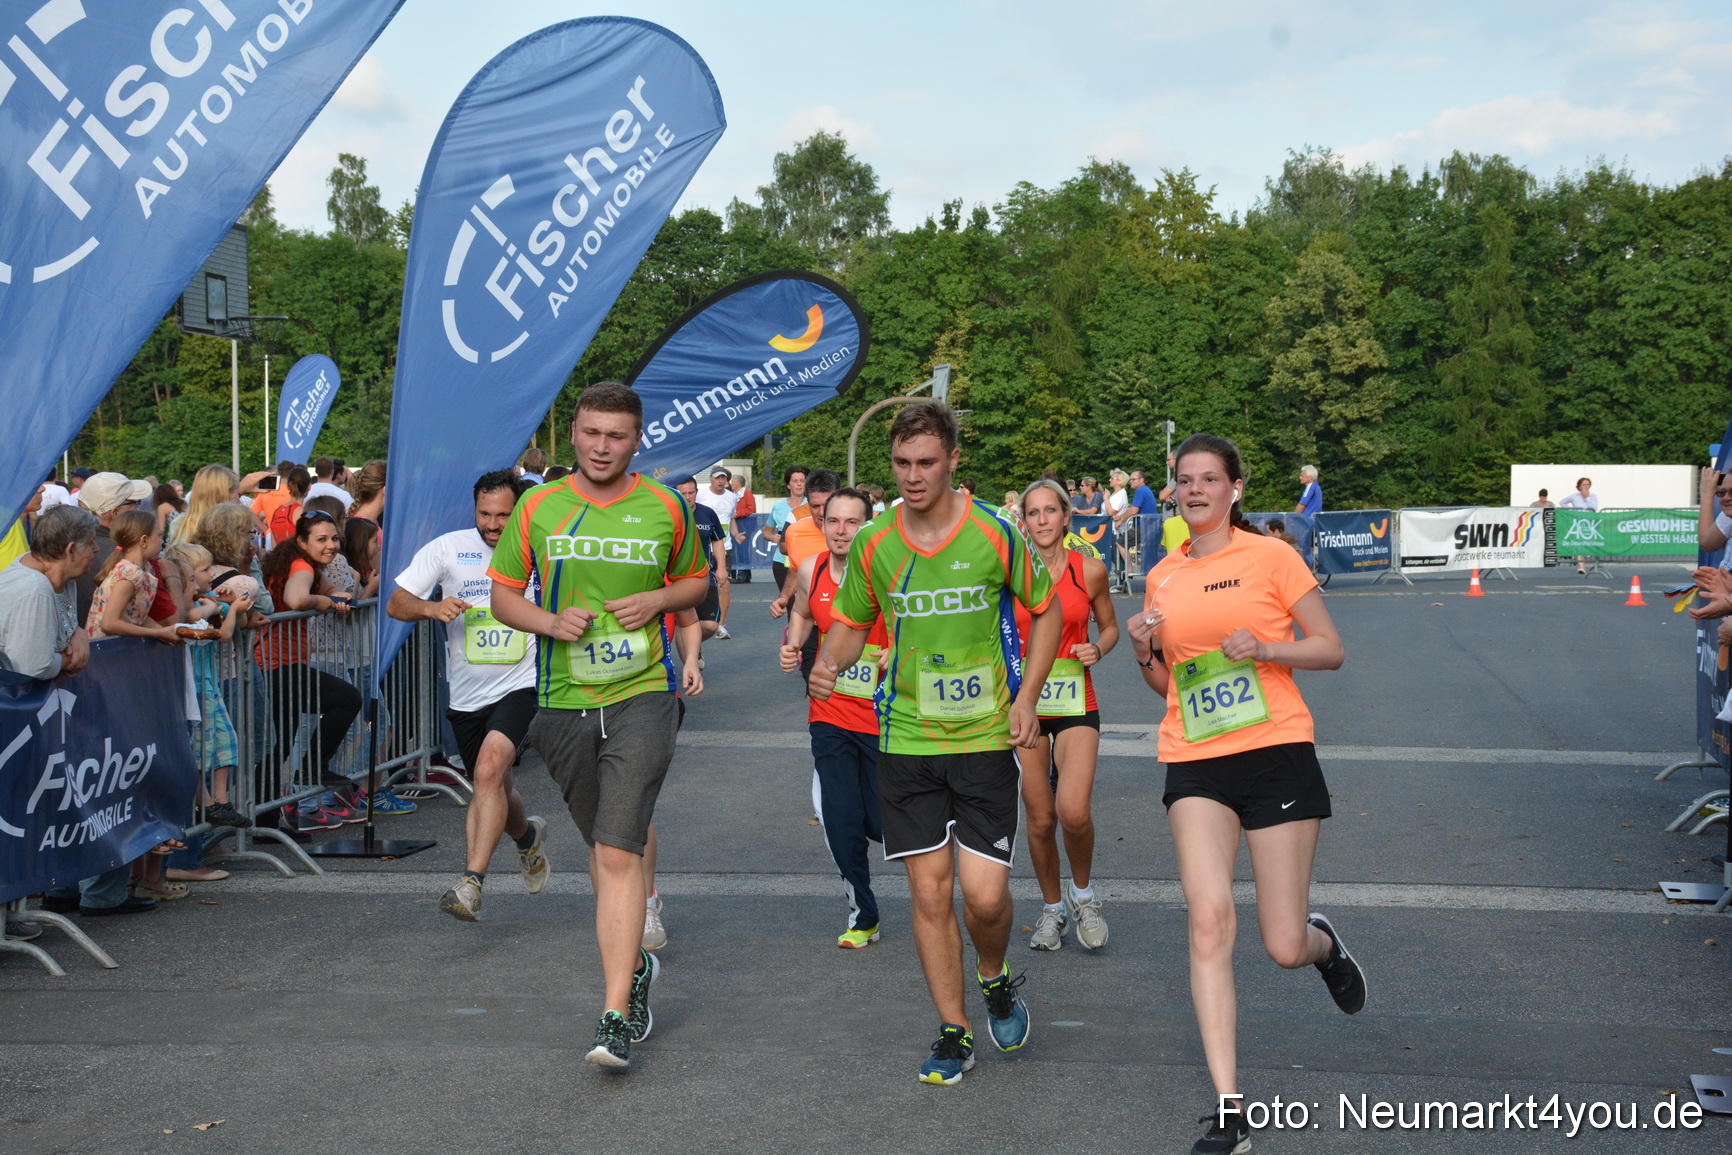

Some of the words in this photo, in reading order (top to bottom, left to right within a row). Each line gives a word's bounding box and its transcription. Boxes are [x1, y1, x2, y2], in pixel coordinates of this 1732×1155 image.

[485, 75, 655, 322] Fischer
[548, 122, 675, 319] AUTOMOBILE
[724, 391, 768, 421] Druck
[770, 376, 798, 396] und
[797, 346, 851, 383] Medien
[293, 369, 327, 437] Fischer
[305, 382, 331, 436] AUTOMOBILE
[633, 357, 788, 457] ischmann
[1319, 530, 1373, 548] Frischmann
[1454, 523, 1509, 550] swn
[1564, 518, 1605, 540] AOK
[1640, 534, 1671, 544] BESTEN
[545, 535, 659, 565] BOCK
[1352, 548, 1364, 556] Druck
[1365, 547, 1373, 555] und
[463, 579, 489, 588] Unser
[1203, 579, 1241, 592] THULE
[887, 585, 990, 617] BOCK
[476, 630, 513, 648] 307
[584, 639, 634, 665] 134
[586, 666, 602, 675] Lukas
[838, 664, 872, 683] 98
[933, 675, 982, 701] 136
[1040, 681, 1076, 700] 371
[1187, 676, 1255, 718] 1562
[26, 737, 157, 815] Fischer
[39, 796, 133, 851] AUTOMOBILE
